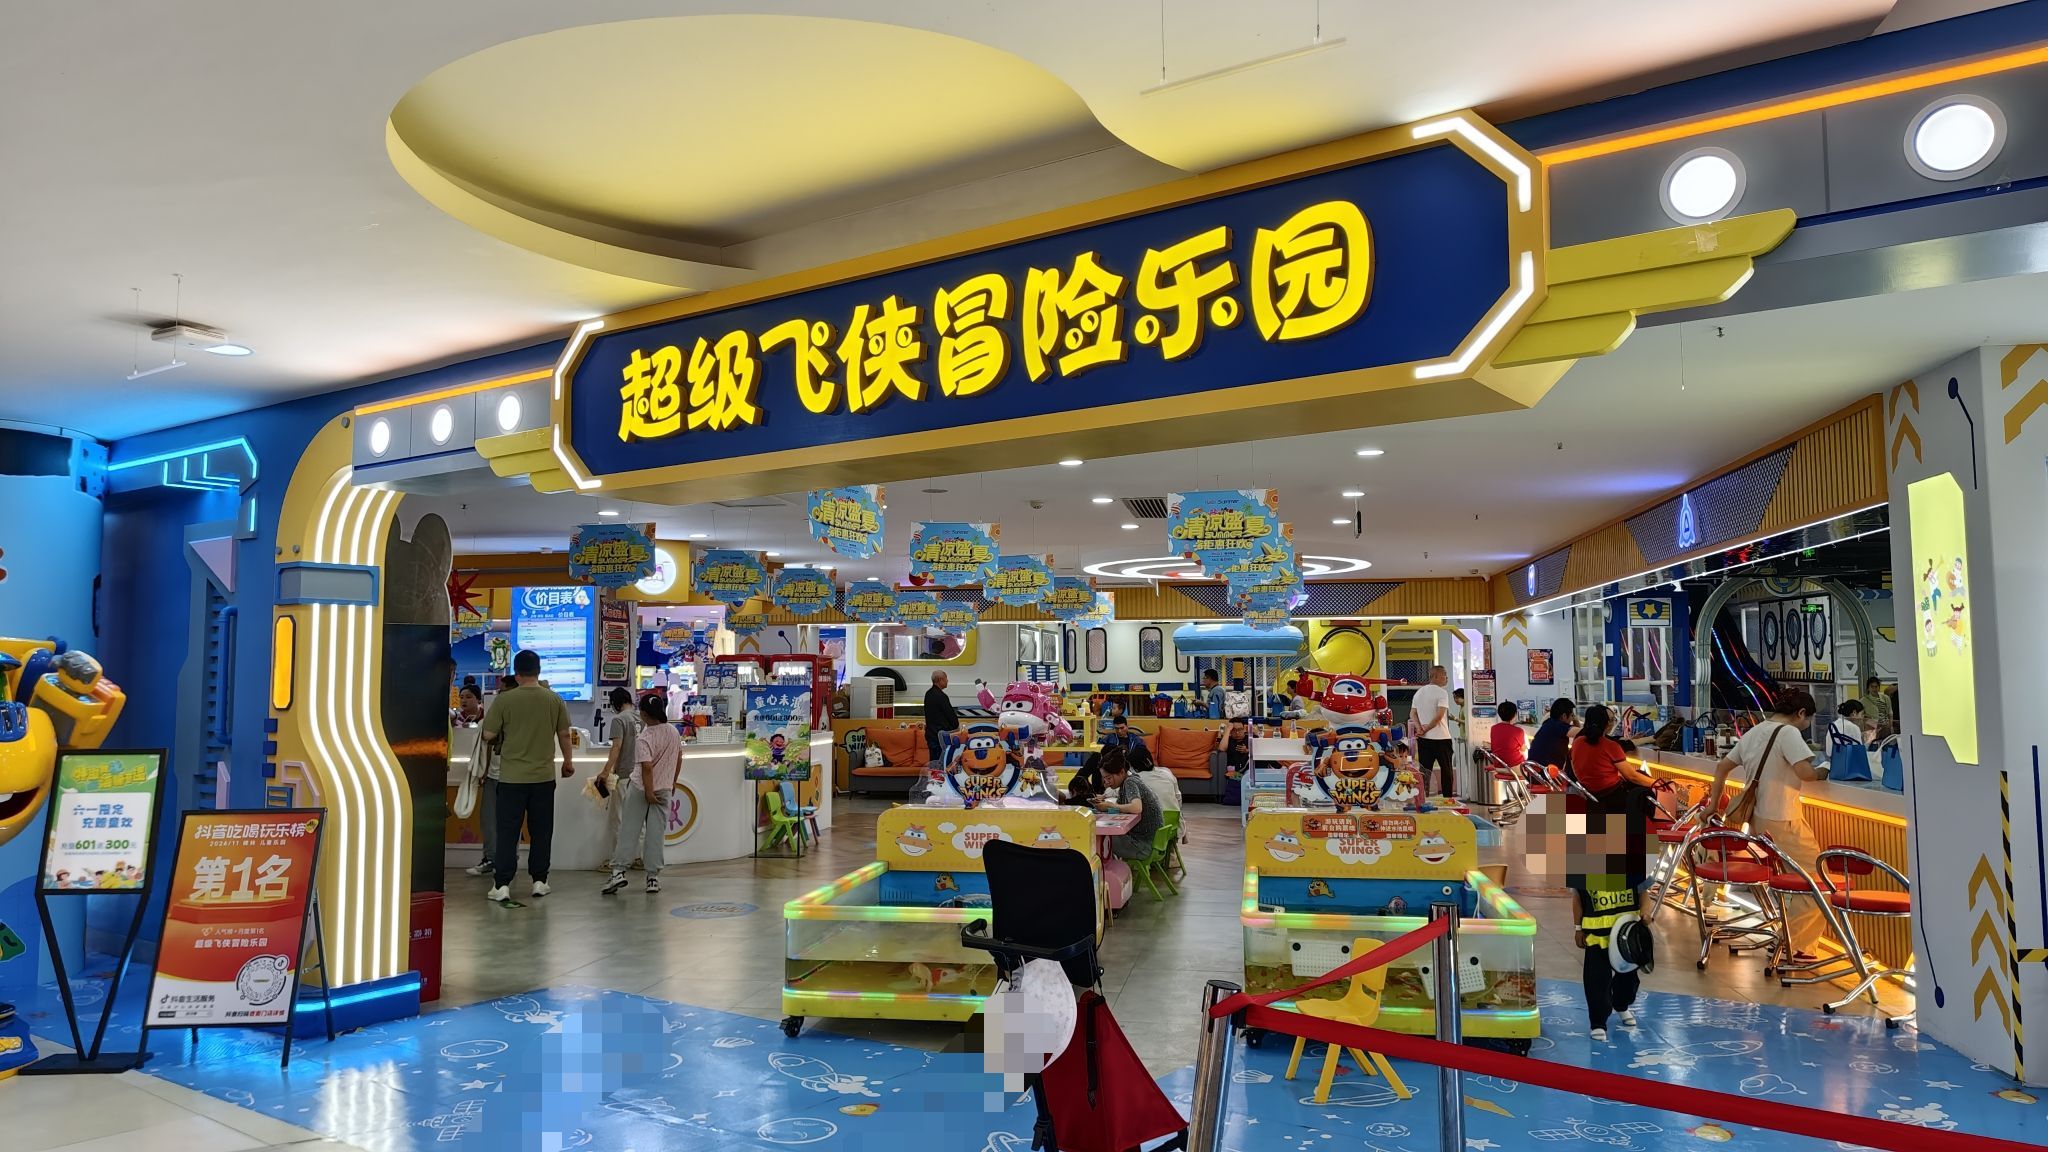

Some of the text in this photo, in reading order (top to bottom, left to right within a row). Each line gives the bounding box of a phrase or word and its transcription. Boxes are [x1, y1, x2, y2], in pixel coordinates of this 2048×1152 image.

[617, 200, 1374, 443] 超级飞侠冒险乐园
[1172, 510, 1272, 539] 清凉盛夏
[914, 540, 993, 562] 清凉盛夏
[986, 569, 1050, 589] 清凉盛夏
[536, 591, 573, 605] 价目表
[965, 775, 1004, 788] SUPER
[1336, 778, 1378, 791] SUPER
[960, 786, 1008, 800] WINGS
[1329, 789, 1382, 804] WINGS
[195, 822, 306, 839] 抖音吃喝玩乐榜
[964, 833, 1000, 841] SUPER
[1339, 838, 1379, 846] SUPER
[1339, 846, 1381, 855] WINGS
[189, 854, 292, 900] 第1名
[1593, 892, 1632, 906] POLICE
[194, 938, 268, 948] 超级飞侠冒险乐园
